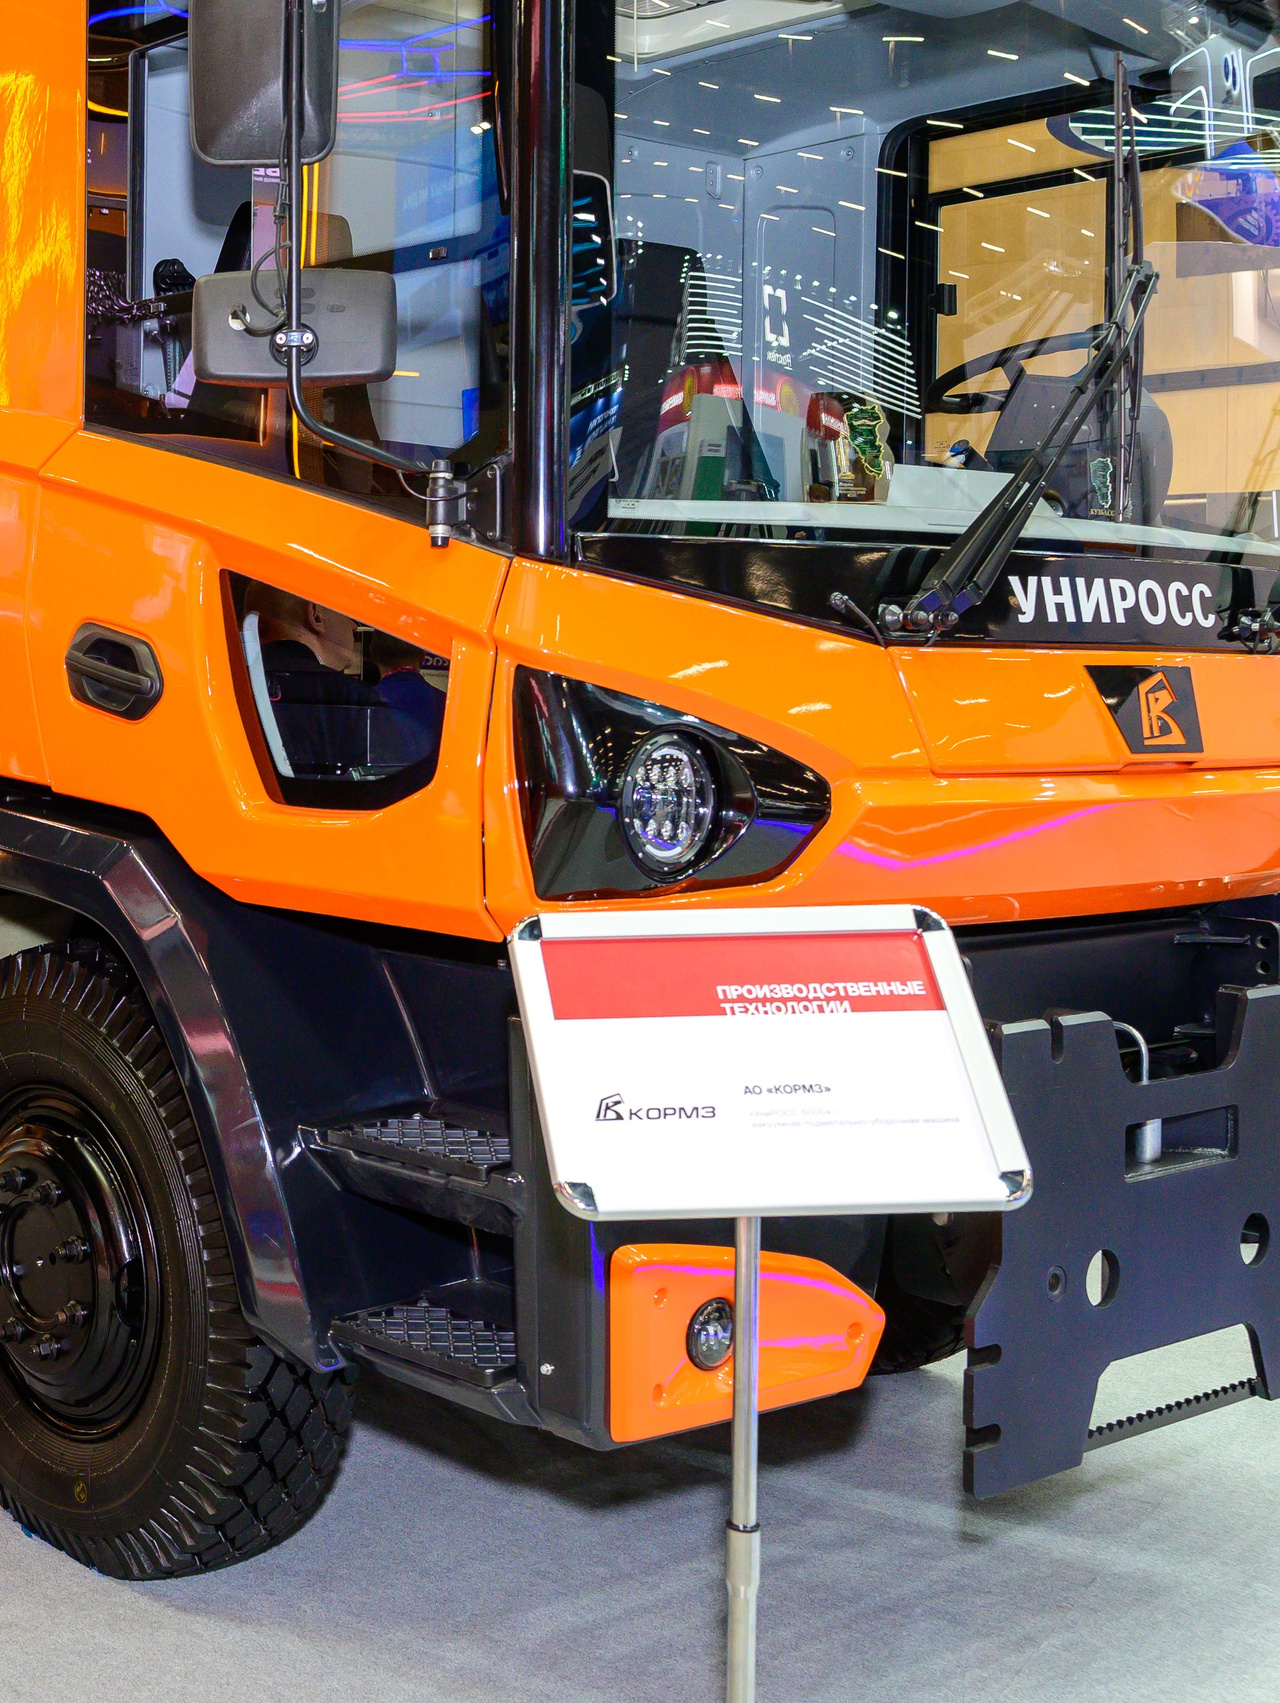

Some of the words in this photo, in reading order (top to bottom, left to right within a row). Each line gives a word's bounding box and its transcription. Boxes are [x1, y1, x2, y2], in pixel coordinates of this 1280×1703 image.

[1007, 575, 1216, 628] УНИРОСС
[716, 981, 927, 1000] ПРОИЗВОДСТВЕННЫЕ
[720, 999, 852, 1016] ТЕХНОЛОГИИ
[744, 1085, 762, 1095] АО
[766, 1083, 831, 1095] «КОРМЗ»
[629, 1106, 716, 1121] КОРМЗ
